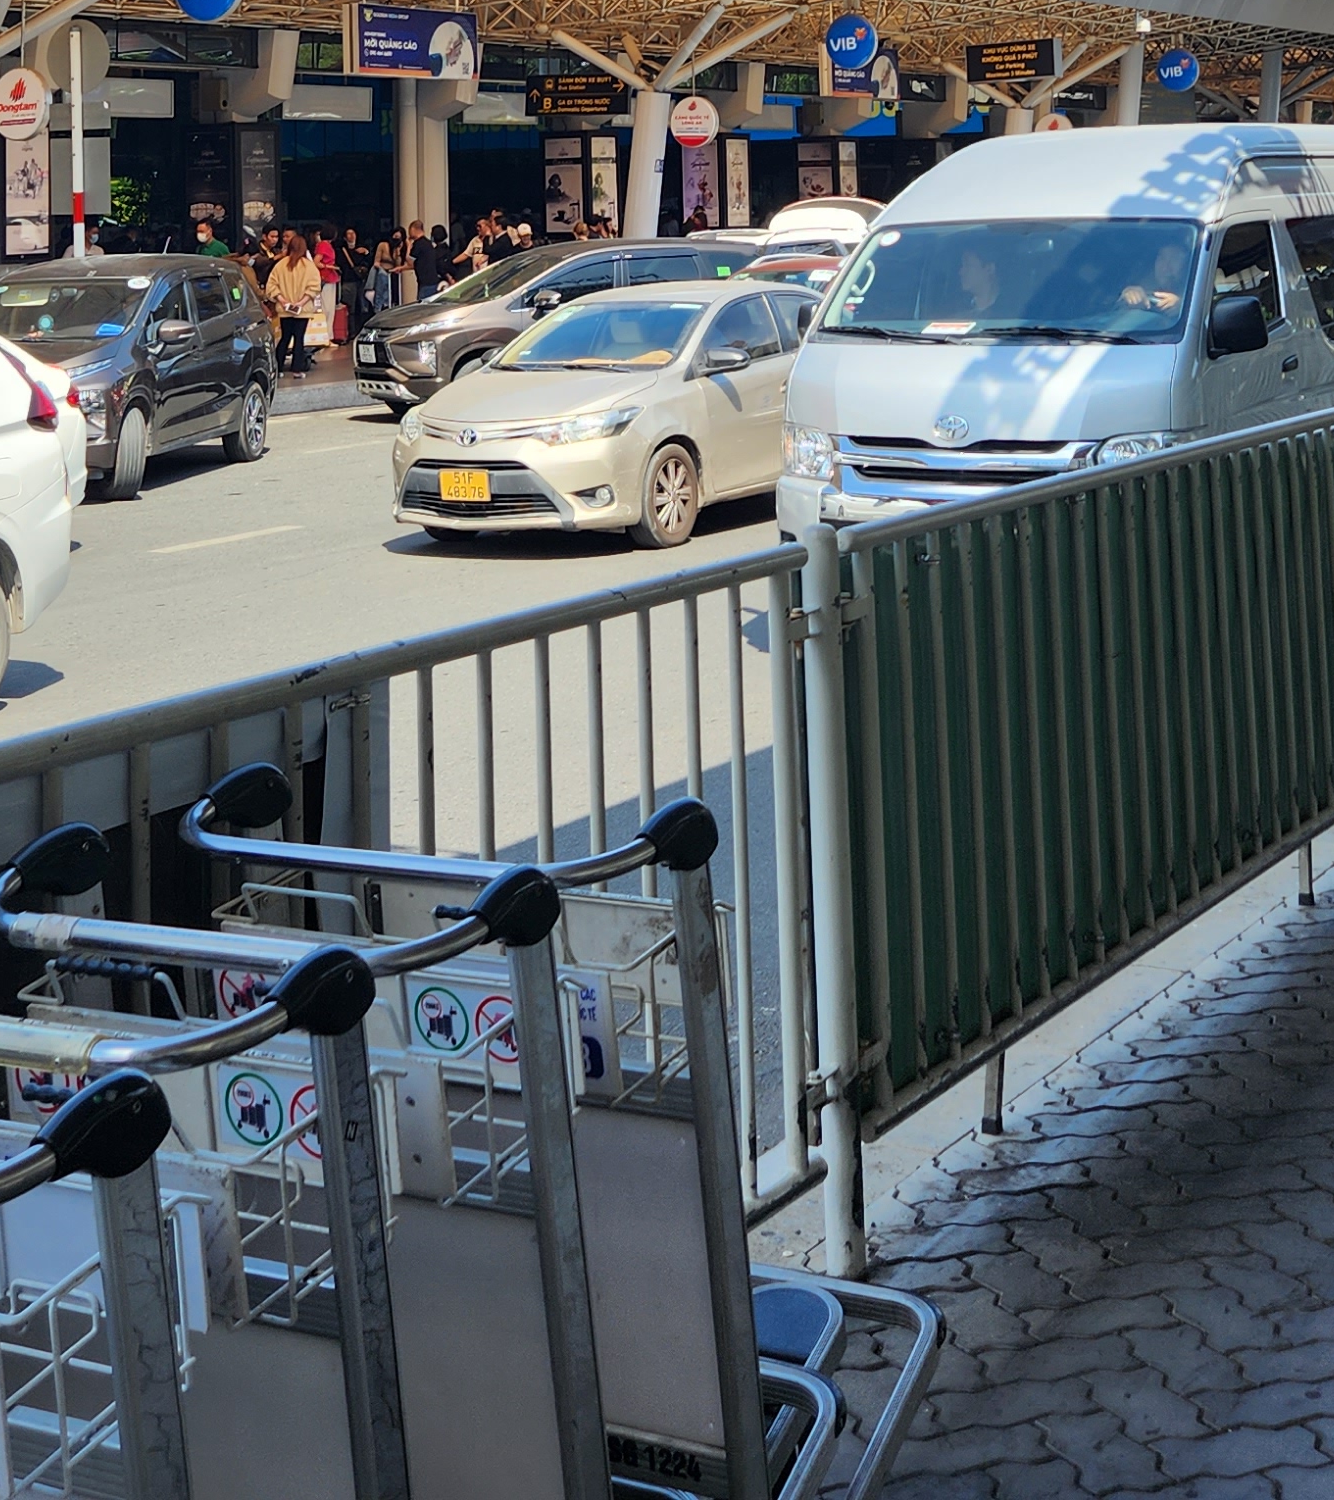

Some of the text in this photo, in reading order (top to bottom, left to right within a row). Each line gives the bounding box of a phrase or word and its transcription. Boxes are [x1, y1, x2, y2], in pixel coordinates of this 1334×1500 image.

[378, 38, 403, 50] QUẢNG
[403, 38, 418, 51] CÁO
[830, 36, 857, 52] VIB
[1027, 43, 1036, 51] XE
[1160, 67, 1184, 79] VIB
[543, 97, 552, 110] B
[453, 472, 474, 485] 51F
[447, 485, 484, 499] 483.76
[643, 1444, 703, 1482] 1224
